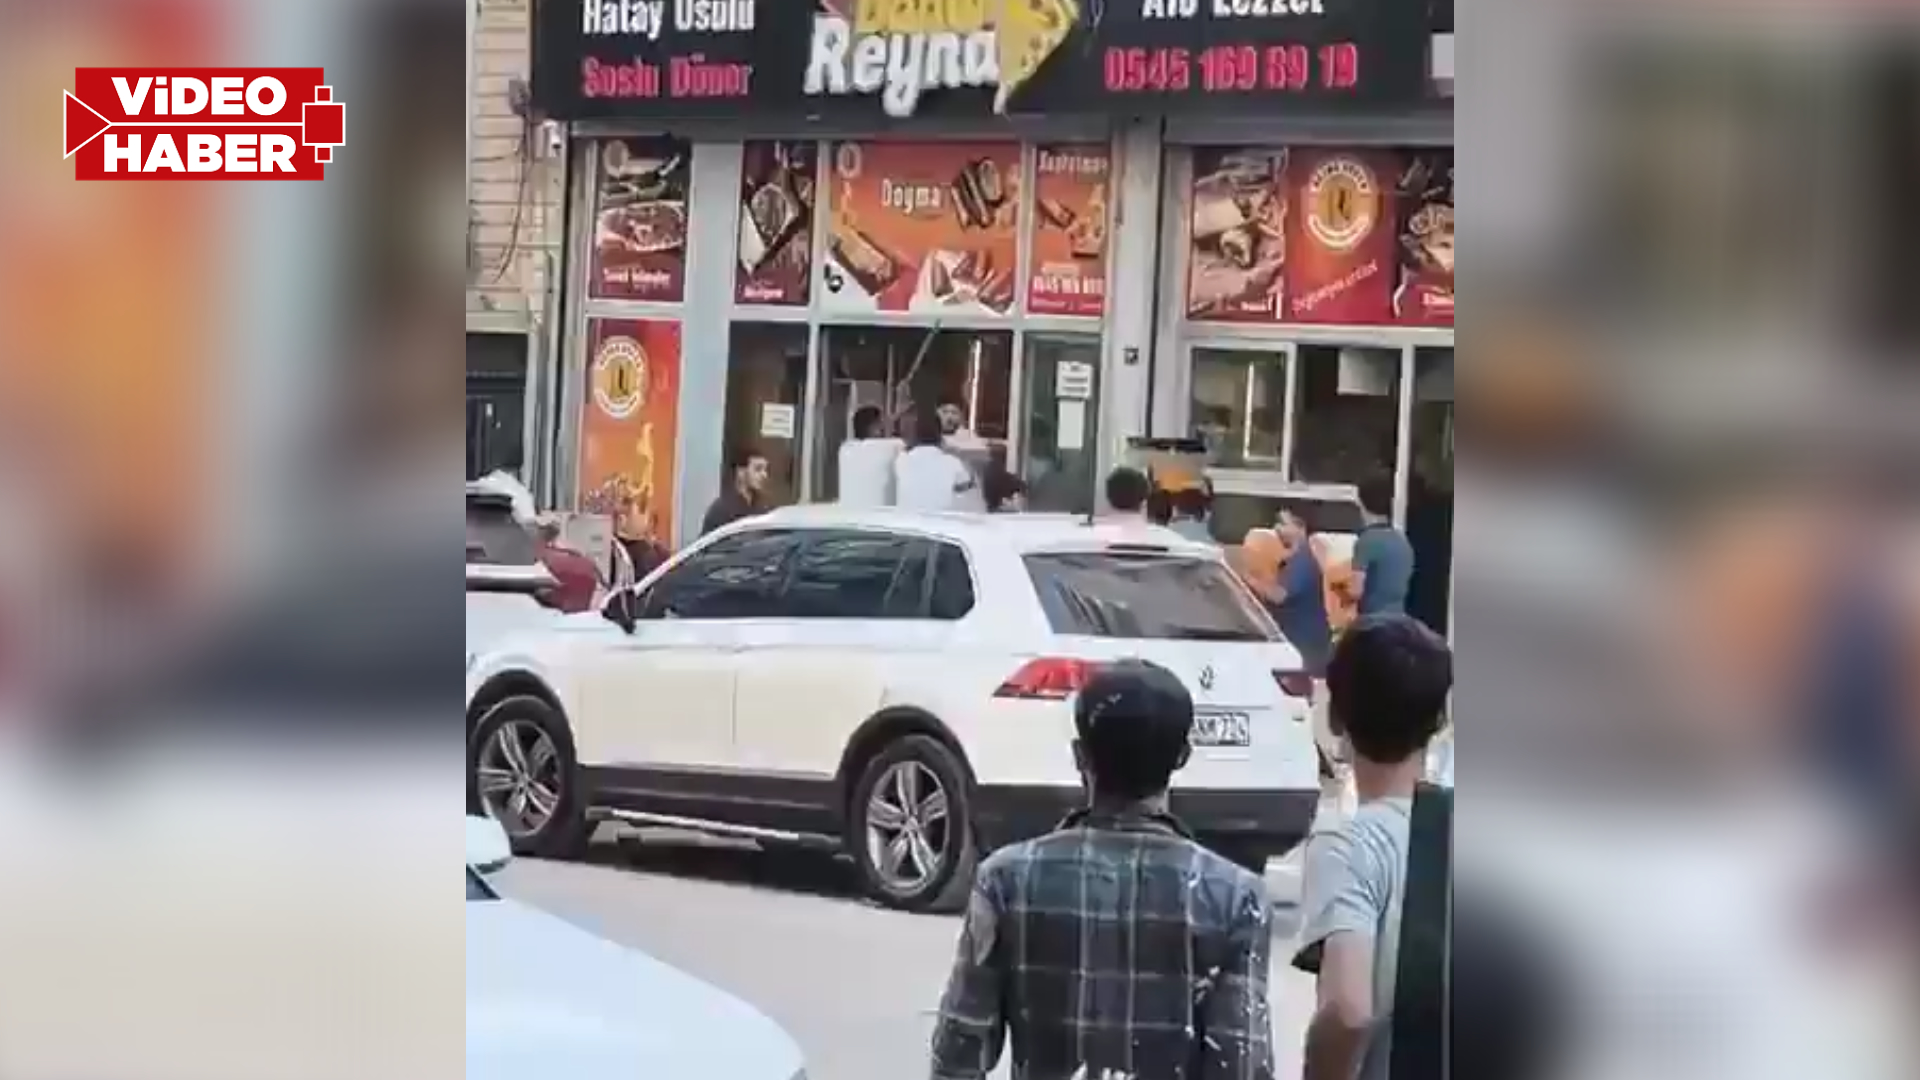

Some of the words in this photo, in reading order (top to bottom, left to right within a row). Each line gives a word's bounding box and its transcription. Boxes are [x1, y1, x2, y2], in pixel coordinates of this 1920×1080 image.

[582, 0, 664, 40] Hatay
[803, 15, 998, 116] Reyna
[1104, 46, 1190, 91] 0545
[1318, 43, 1359, 88] 19
